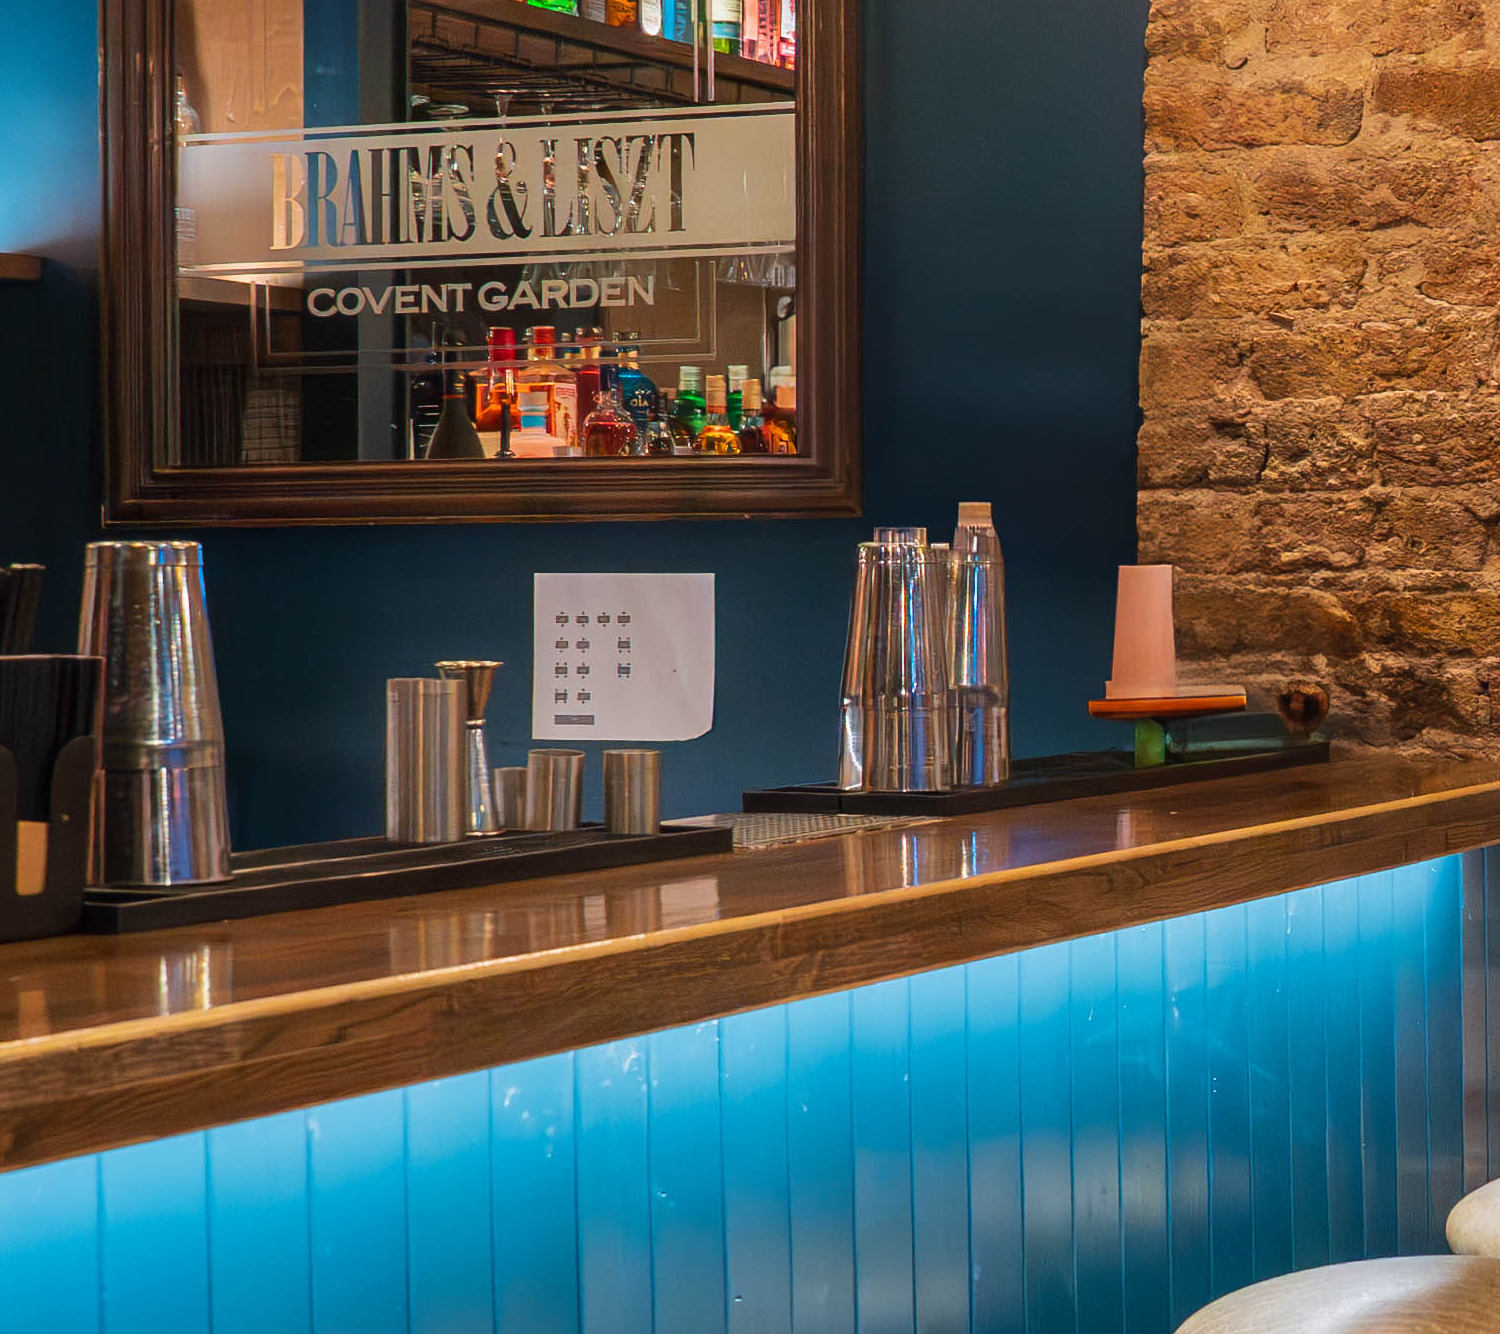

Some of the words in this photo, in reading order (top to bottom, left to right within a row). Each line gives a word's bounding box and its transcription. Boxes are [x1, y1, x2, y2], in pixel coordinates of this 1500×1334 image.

[269, 145, 477, 251] BRAHMS
[487, 140, 533, 240] &
[539, 132, 696, 238] LISZT
[307, 282, 473, 317] COVENT
[477, 275, 655, 312] GARDEN
